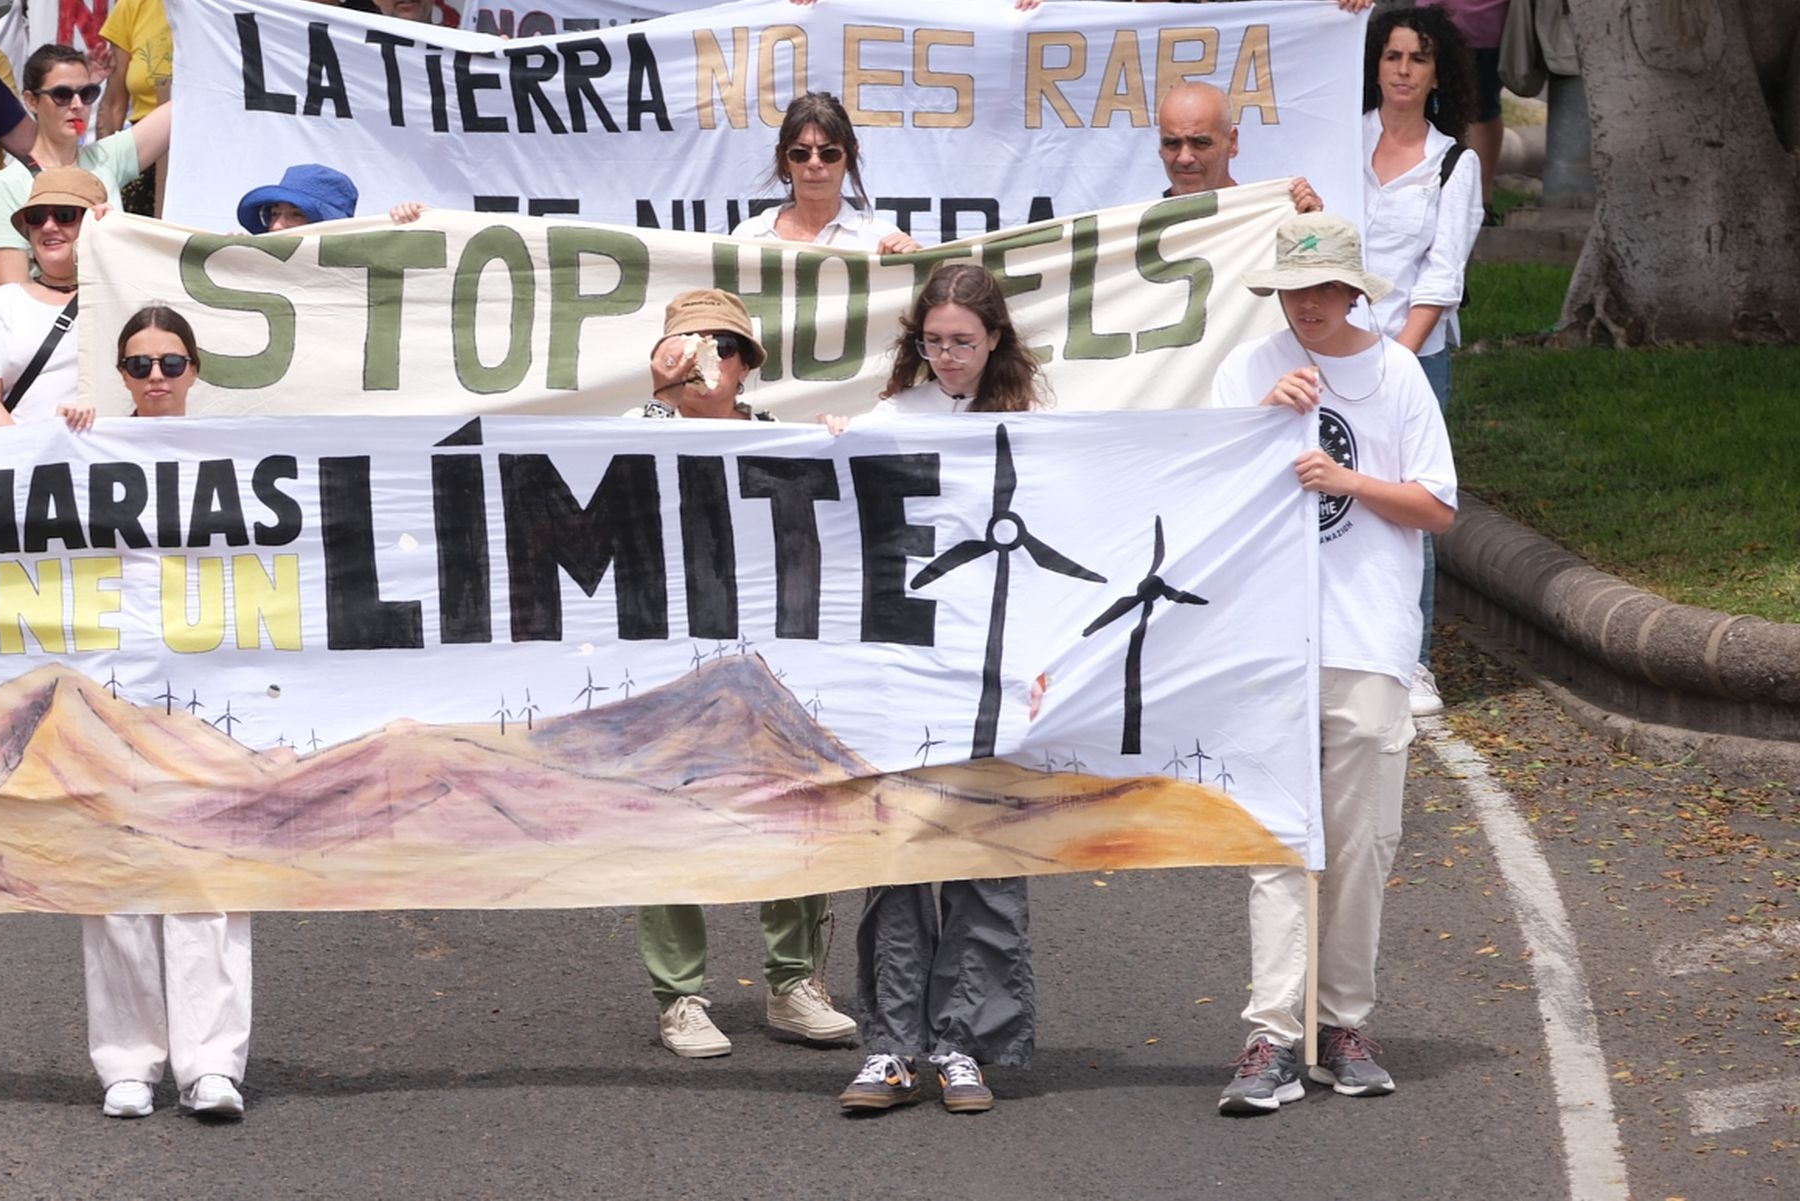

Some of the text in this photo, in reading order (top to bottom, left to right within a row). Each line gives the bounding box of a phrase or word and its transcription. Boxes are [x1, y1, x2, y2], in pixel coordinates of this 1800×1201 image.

[234, 11, 353, 119] LA
[693, 25, 810, 130] NO
[842, 23, 975, 129] ES
[179, 224, 651, 395] STOP
[160, 553, 304, 654] UN
[318, 416, 942, 650] LÍMITE
